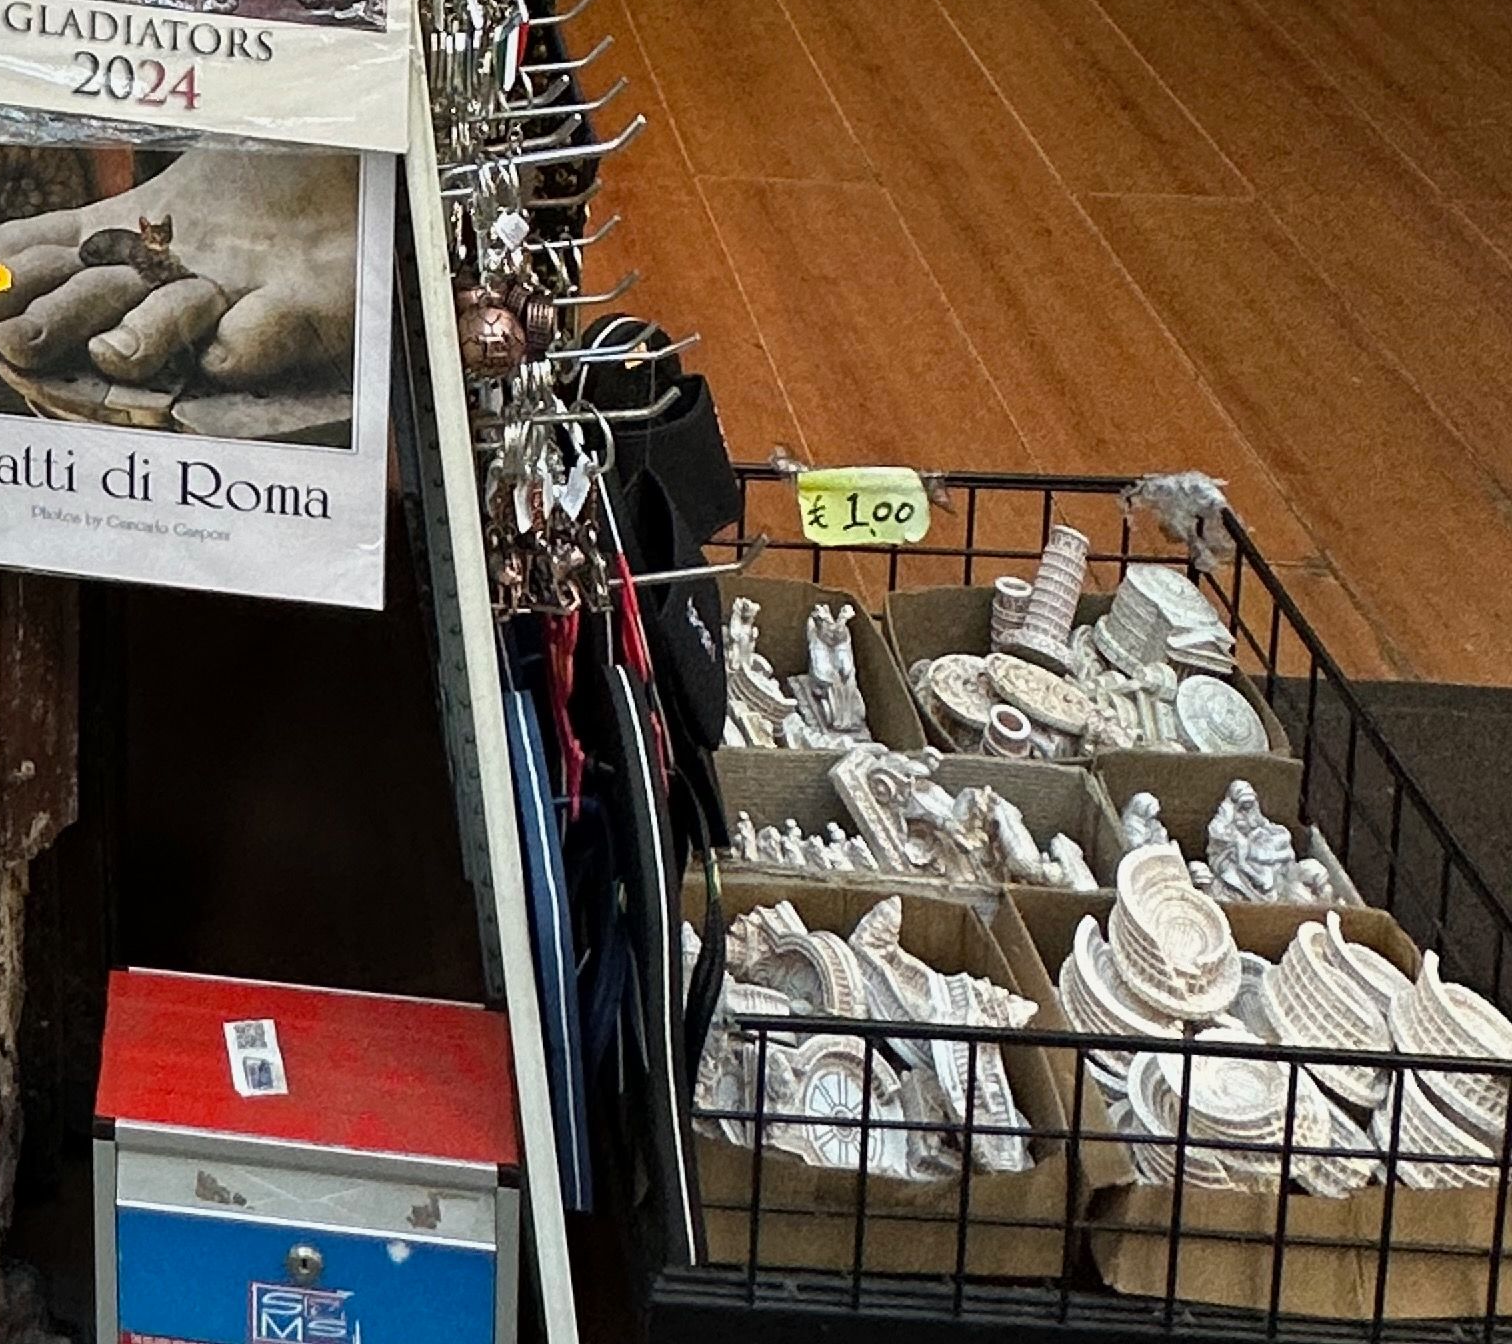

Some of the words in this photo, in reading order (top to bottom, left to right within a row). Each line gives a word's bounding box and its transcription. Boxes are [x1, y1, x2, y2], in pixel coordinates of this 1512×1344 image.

[2, 0, 274, 63] GLADIATORS
[71, 49, 202, 111] 2024
[101, 451, 152, 502] di
[175, 459, 332, 520] Roma
